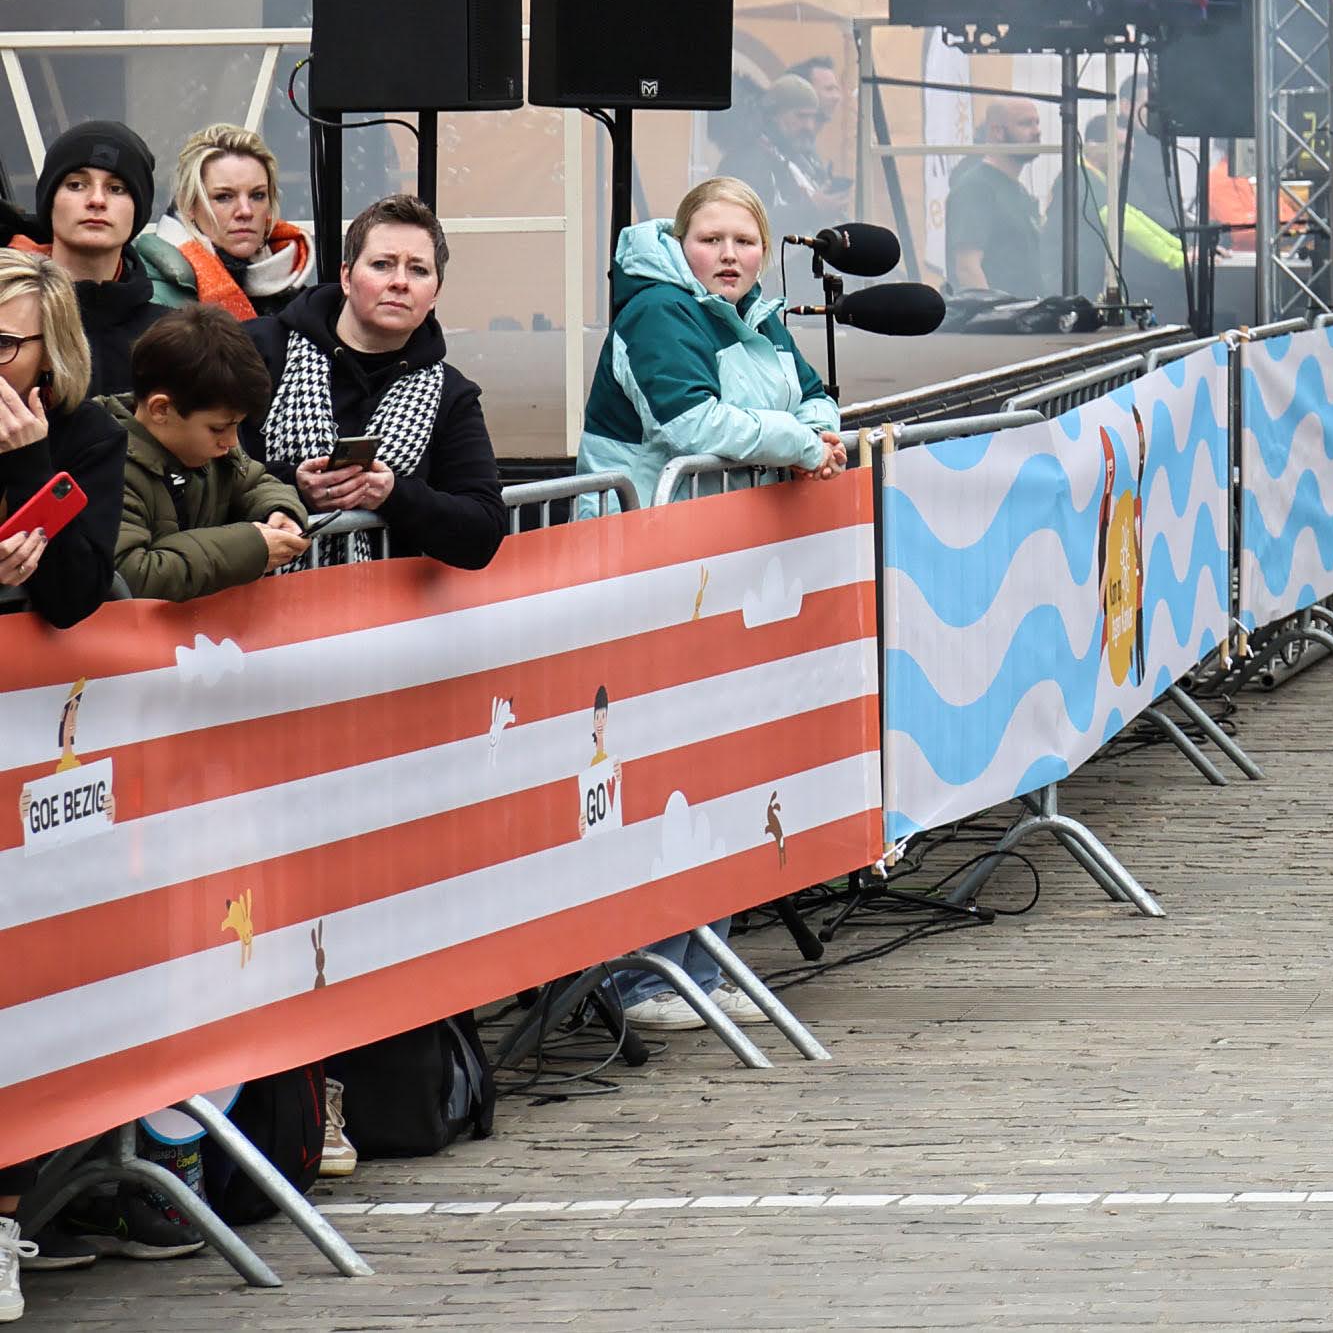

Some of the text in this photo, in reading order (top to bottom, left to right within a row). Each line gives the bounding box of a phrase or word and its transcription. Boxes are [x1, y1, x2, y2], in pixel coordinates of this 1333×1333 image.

[30, 780, 106, 834] GOE BEZIG
[587, 782, 606, 827] GO
